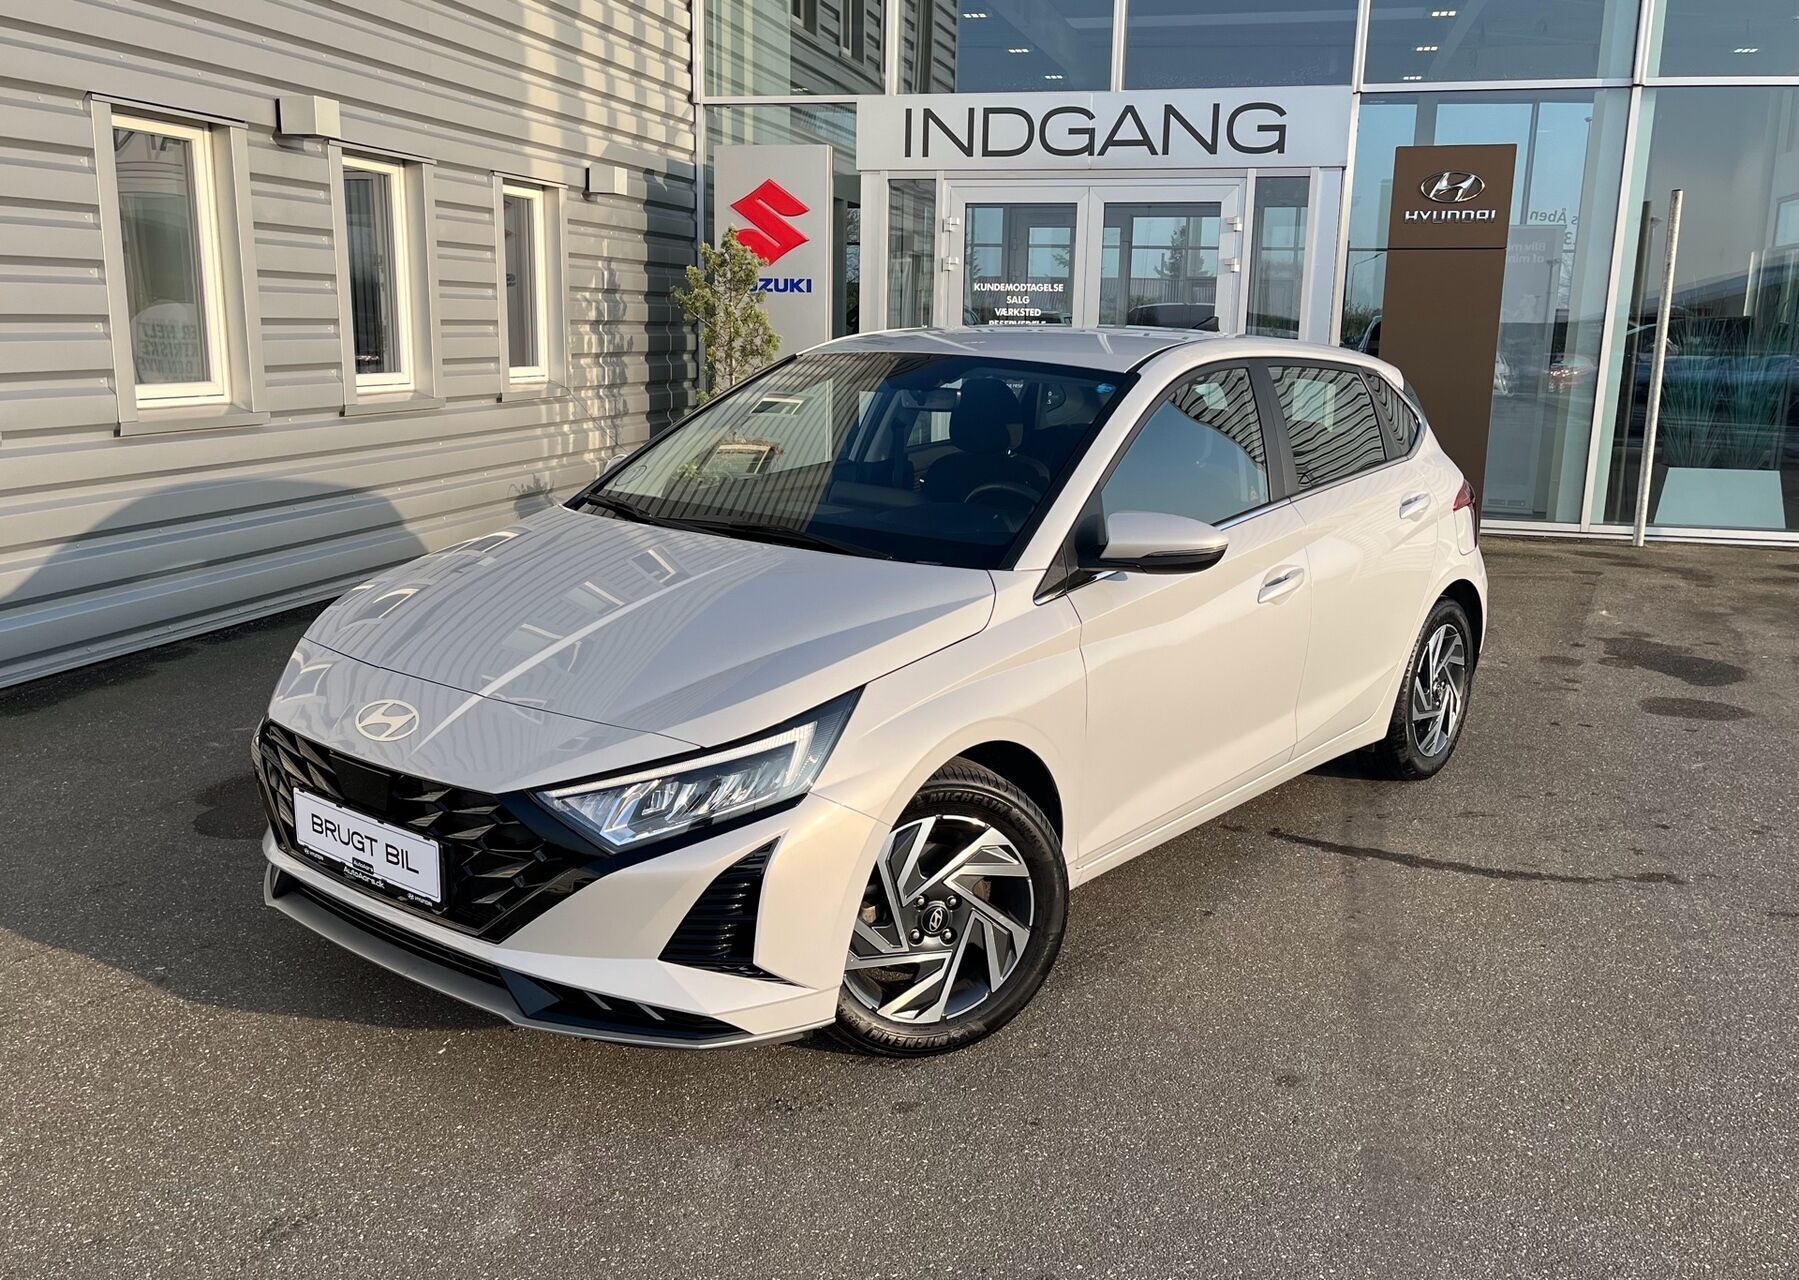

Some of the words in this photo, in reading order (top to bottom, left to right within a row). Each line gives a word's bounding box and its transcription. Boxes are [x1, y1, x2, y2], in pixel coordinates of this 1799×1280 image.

[904, 102, 1287, 158] INDGANG
[1404, 209, 1496, 224] HYUNDAI
[974, 283, 1064, 292] KUNDEMODTAGELSE
[1006, 296, 1030, 304] SALG
[994, 307, 1042, 317] VÆRKSTED
[929, 792, 1010, 817] MICHELIN
[311, 813, 378, 856] BRUGT
[385, 843, 420, 875] BIL
[869, 1028, 949, 1049] MICHELIN
